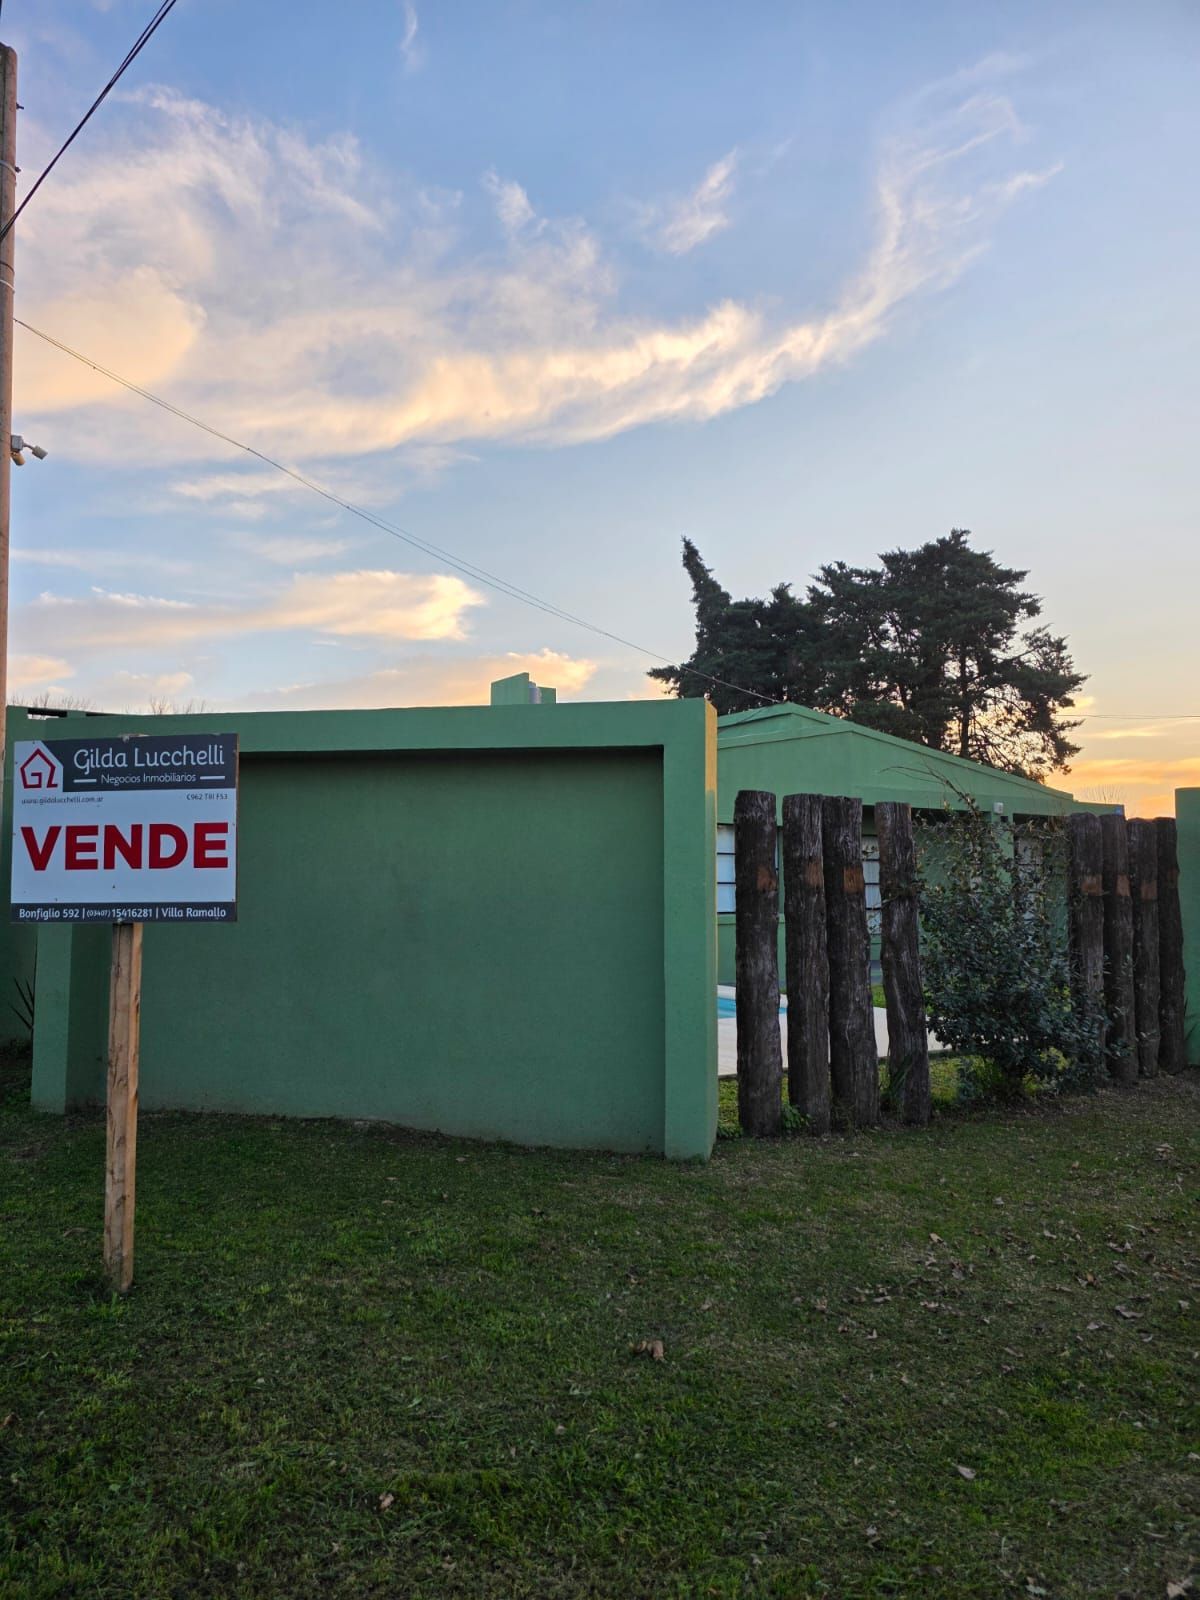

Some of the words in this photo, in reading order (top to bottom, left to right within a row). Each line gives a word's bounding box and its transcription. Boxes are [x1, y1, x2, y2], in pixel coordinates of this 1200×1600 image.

[73, 747, 128, 775] Gilda
[134, 744, 225, 767] Lucchelli
[101, 773, 141, 786] Negocios
[143, 771, 197, 783] Inmobiliarios
[20, 822, 229, 871] VENDE
[19, 908, 61, 920] Bonfiglio
[62, 908, 80, 918] 592
[112, 907, 153, 918] 15416281
[161, 907, 183, 918] Villa
[186, 906, 227, 917] Ramallo
